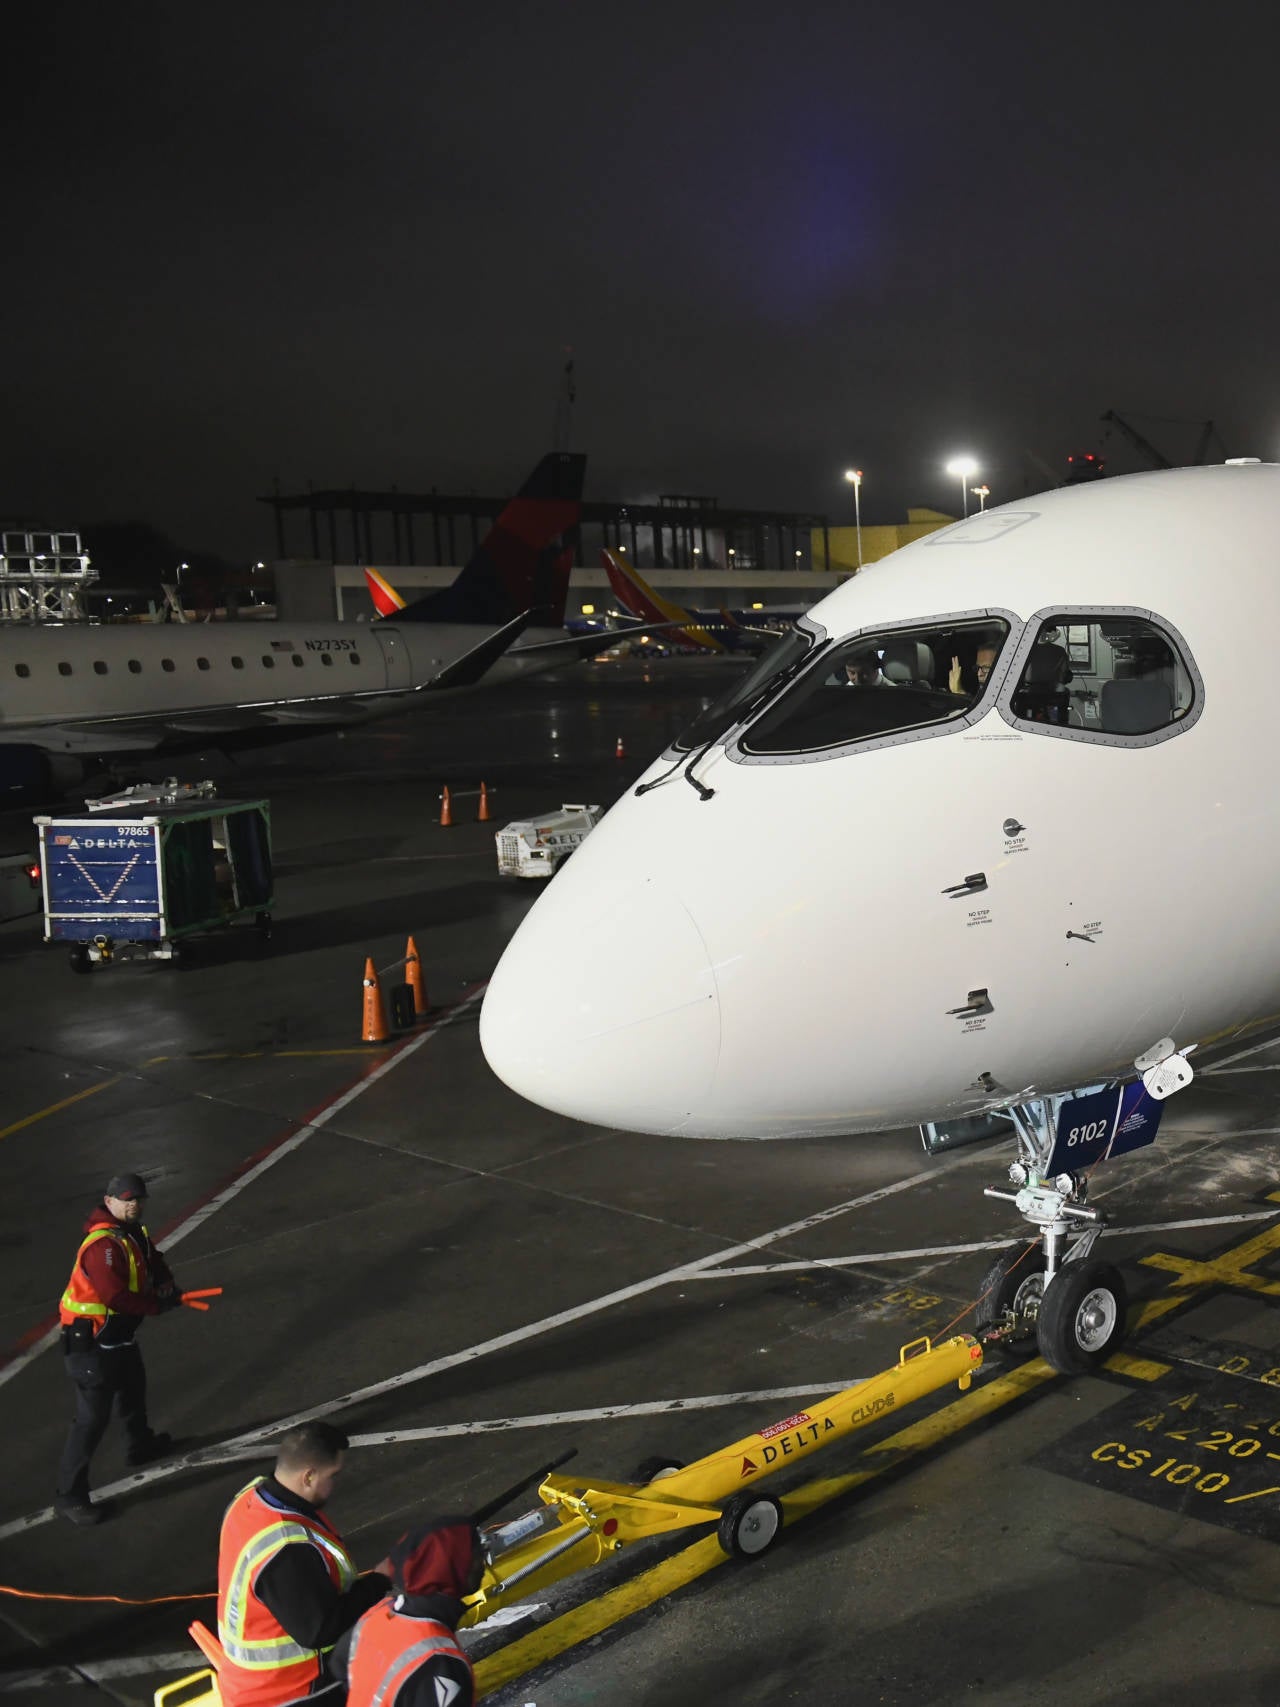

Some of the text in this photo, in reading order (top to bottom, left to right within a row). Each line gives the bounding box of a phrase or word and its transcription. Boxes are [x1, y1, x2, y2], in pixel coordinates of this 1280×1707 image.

[304, 639, 357, 651] N273SY
[117, 827, 149, 836] 97865
[84, 839, 138, 849] DELTA
[548, 833, 584, 846] DELT
[1067, 1119, 1108, 1147] 8102
[762, 1417, 835, 1465] DELTA
